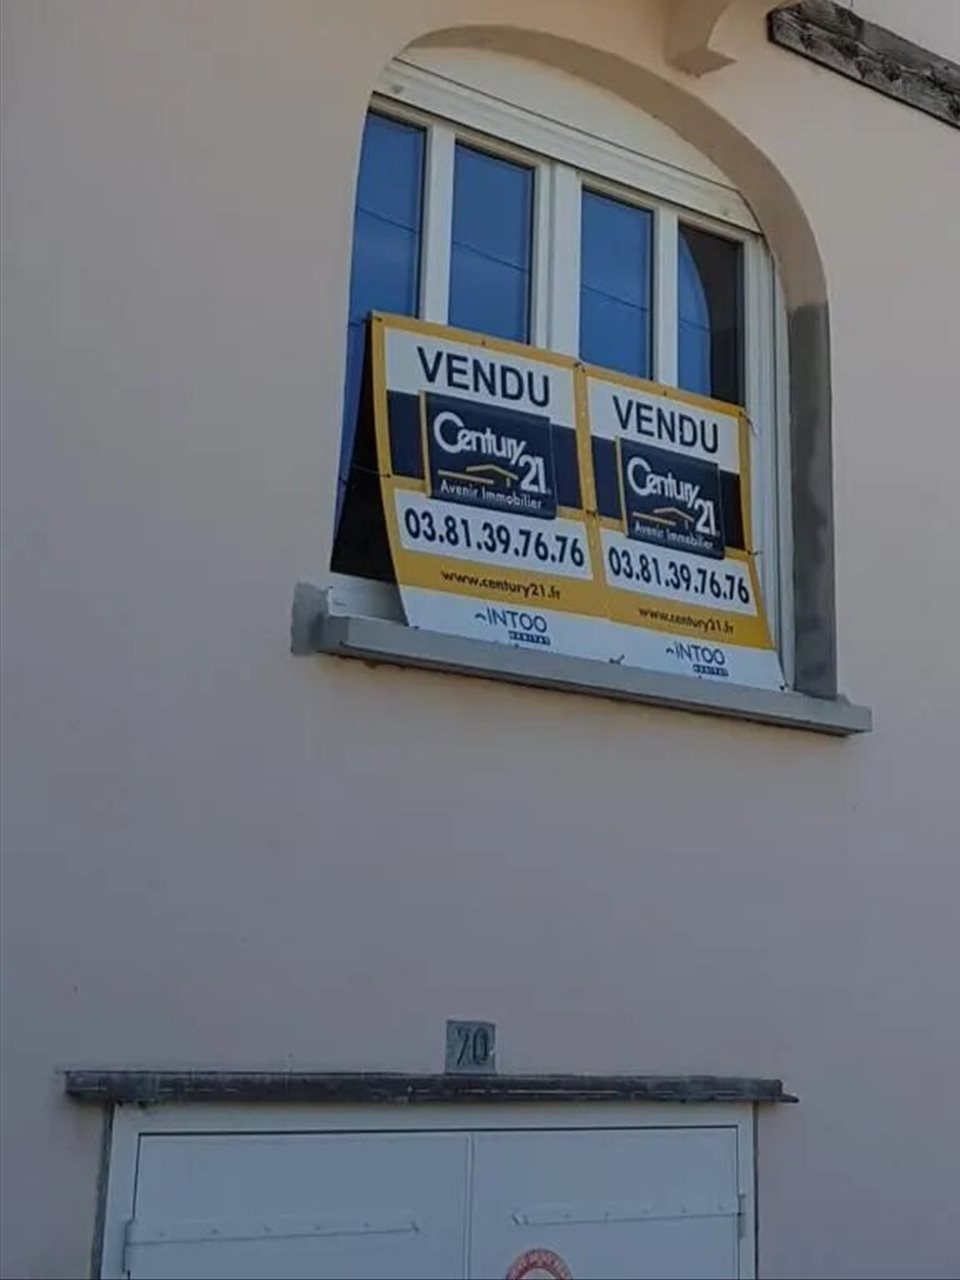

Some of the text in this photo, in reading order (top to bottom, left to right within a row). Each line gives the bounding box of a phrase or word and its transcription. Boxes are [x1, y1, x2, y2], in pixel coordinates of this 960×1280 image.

[417, 346, 550, 407] VENDU
[433, 411, 547, 495] Century 21
[613, 395, 719, 454] VENDU
[440, 479, 542, 510] Avenir Immobilier
[627, 456, 716, 536] Century 21
[404, 508, 585, 567] 03.81.39.76.76
[441, 570, 561, 601] www.century21.fr
[608, 548, 750, 605] 03.81.39.76.76
[486, 607, 548, 633] INTOO
